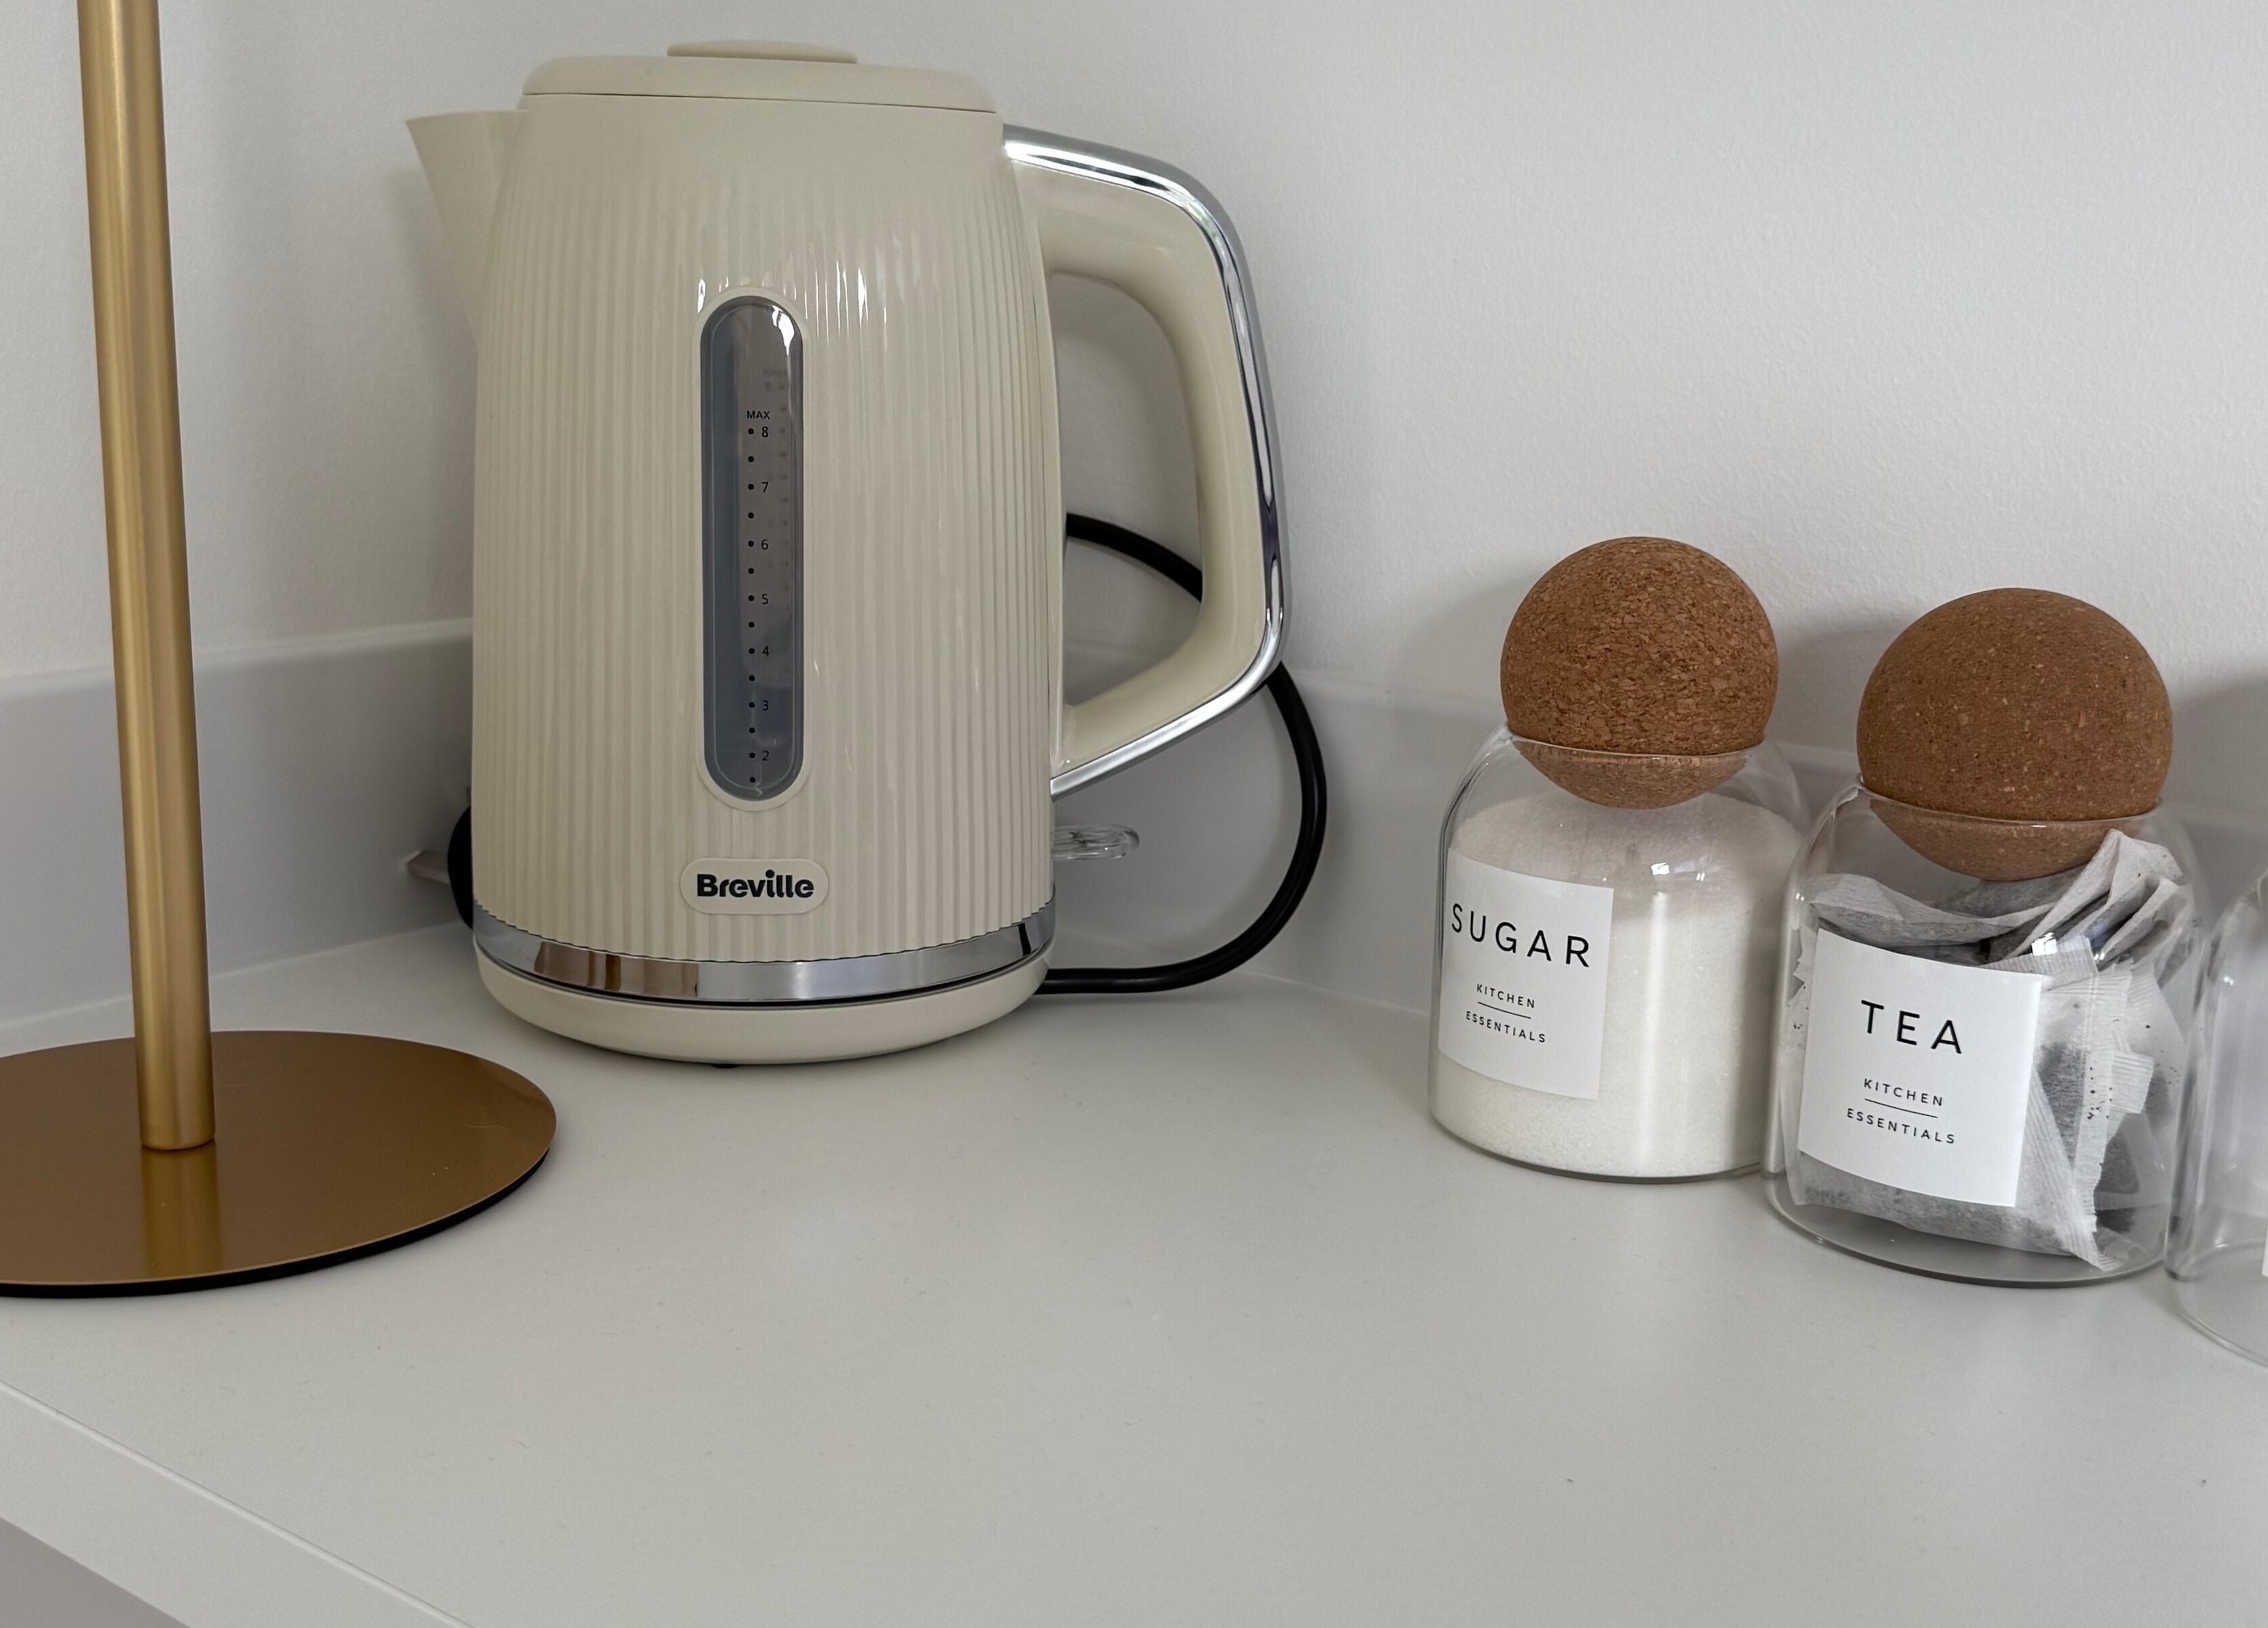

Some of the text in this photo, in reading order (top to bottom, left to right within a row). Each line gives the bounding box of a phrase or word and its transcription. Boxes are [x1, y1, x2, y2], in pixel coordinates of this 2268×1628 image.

[746, 410, 770, 420] MAX
[761, 426, 769, 438] 8
[761, 482, 769, 493] 7
[761, 539, 769, 551] 6
[762, 593, 769, 605] 5
[762, 646, 769, 657] 4
[762, 700, 769, 711] 3
[762, 751, 769, 761] 2
[697, 869, 815, 898] Breville
[1451, 902, 1589, 967] SUGAR
[1476, 984, 1535, 1009] KITCHEN
[1466, 1011, 1546, 1043] ESSENTIALS
[1861, 999, 1963, 1054] TEA
[1863, 1078, 1943, 1106] KITCHEN
[1847, 1107, 1955, 1144] ESSENTIALS
